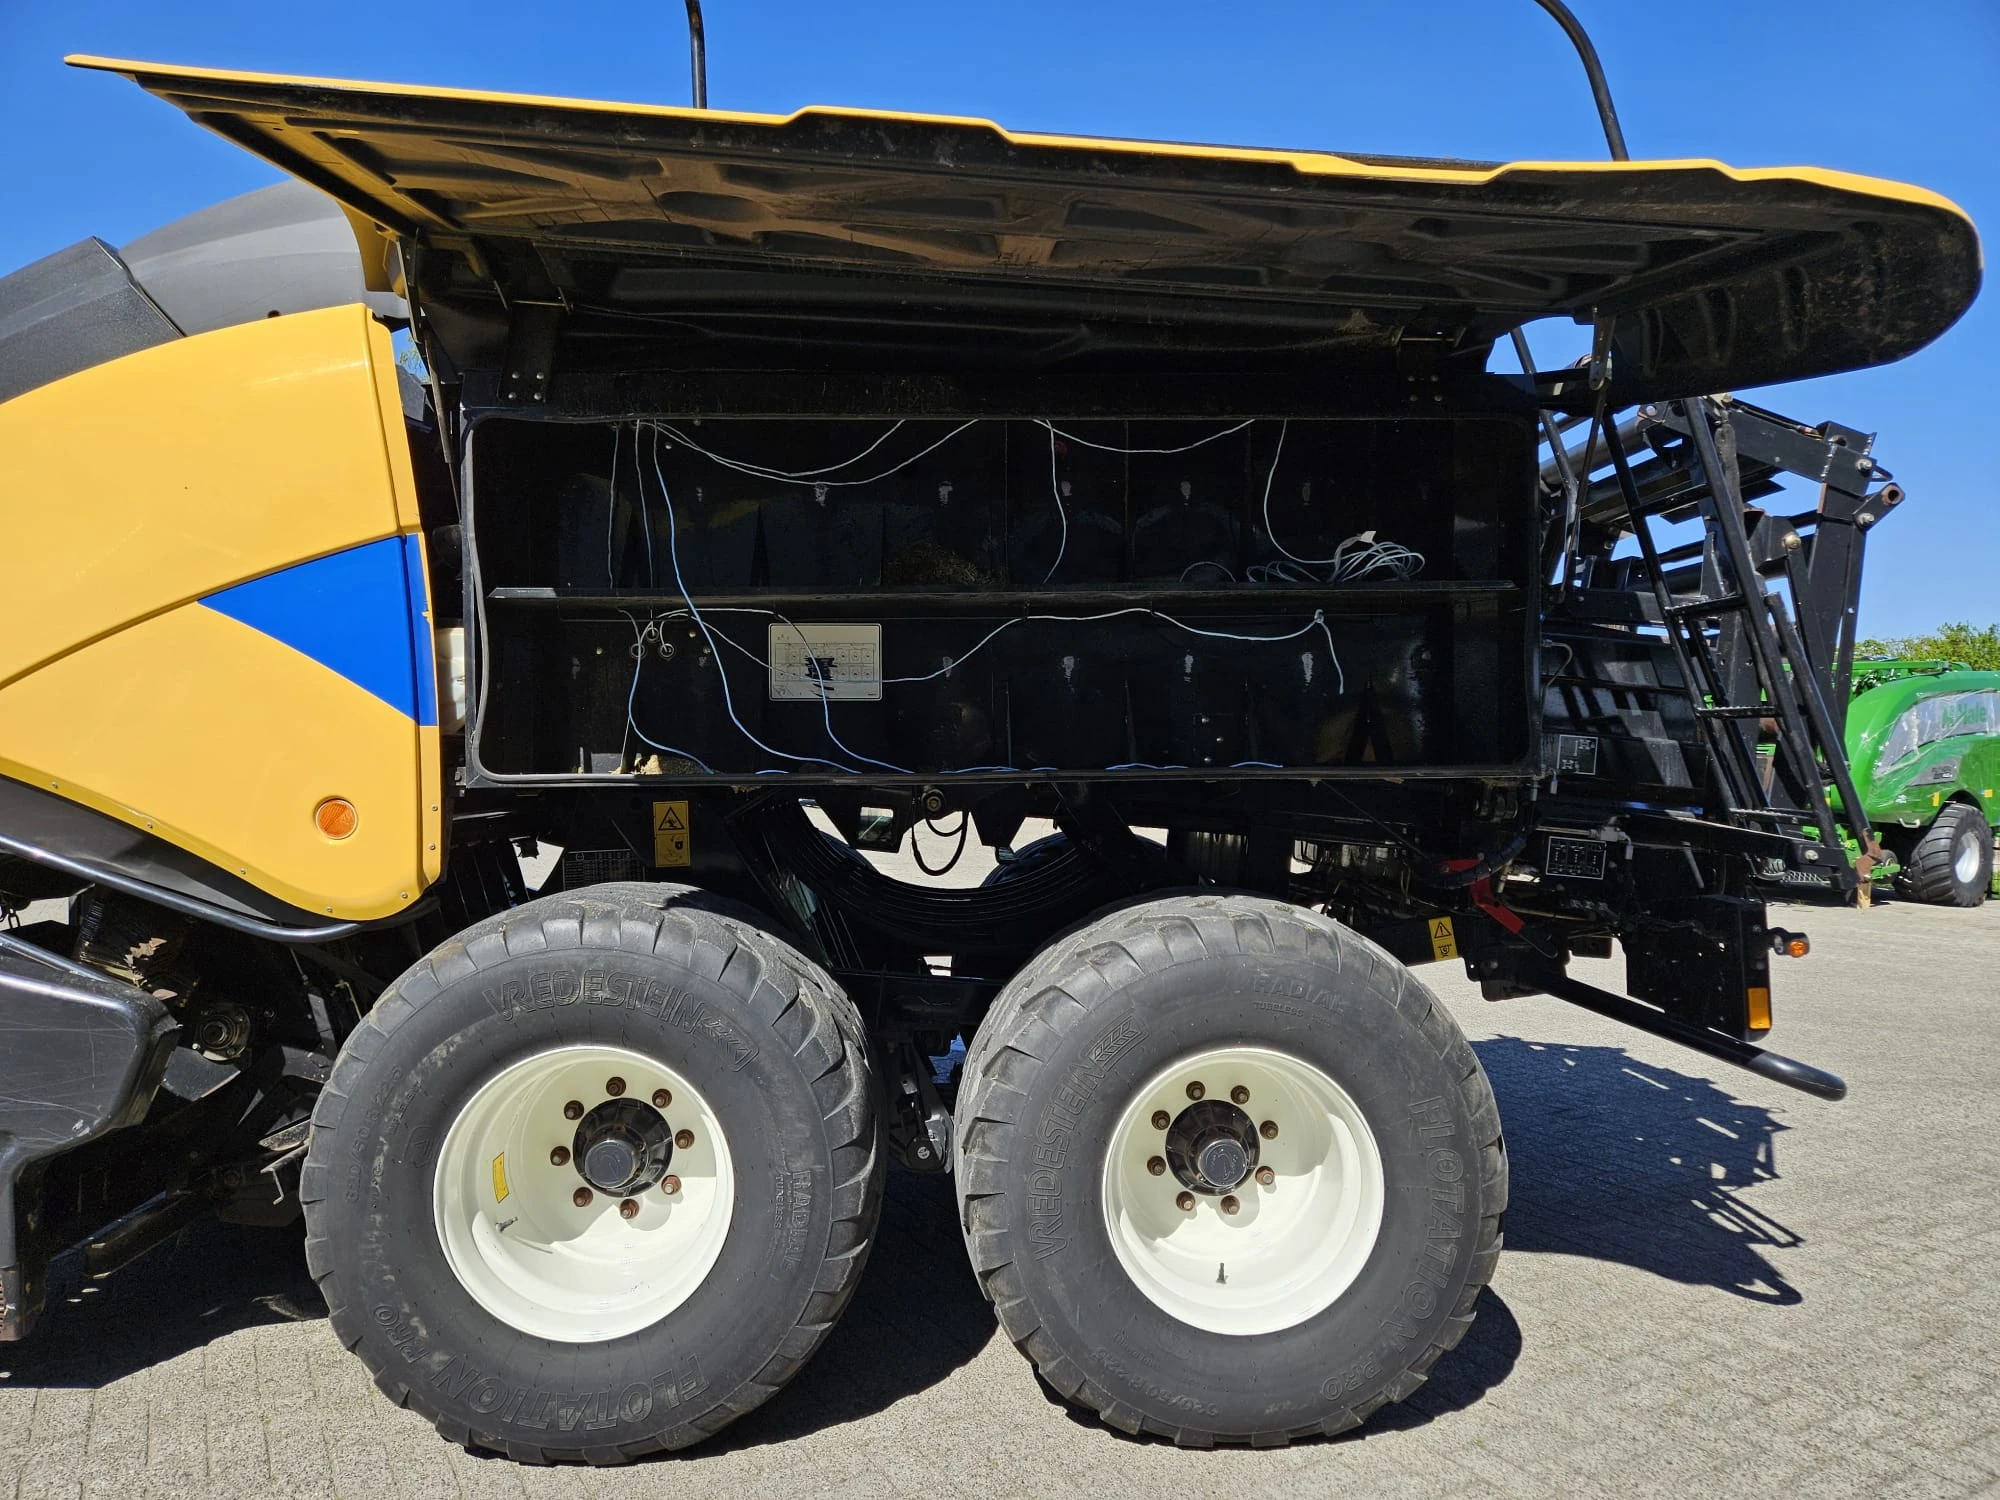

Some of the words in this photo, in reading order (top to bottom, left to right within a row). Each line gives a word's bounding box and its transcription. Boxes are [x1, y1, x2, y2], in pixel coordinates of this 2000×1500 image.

[481, 969, 706, 1036] VREDESTEIN
[1027, 1060, 1106, 1262] VREDESTEIN
[1379, 1096, 1465, 1352] FLOTATION
[373, 1303, 429, 1364] PRO
[430, 1353, 711, 1432] FLOTATION
[1319, 1352, 1384, 1401] PRO
